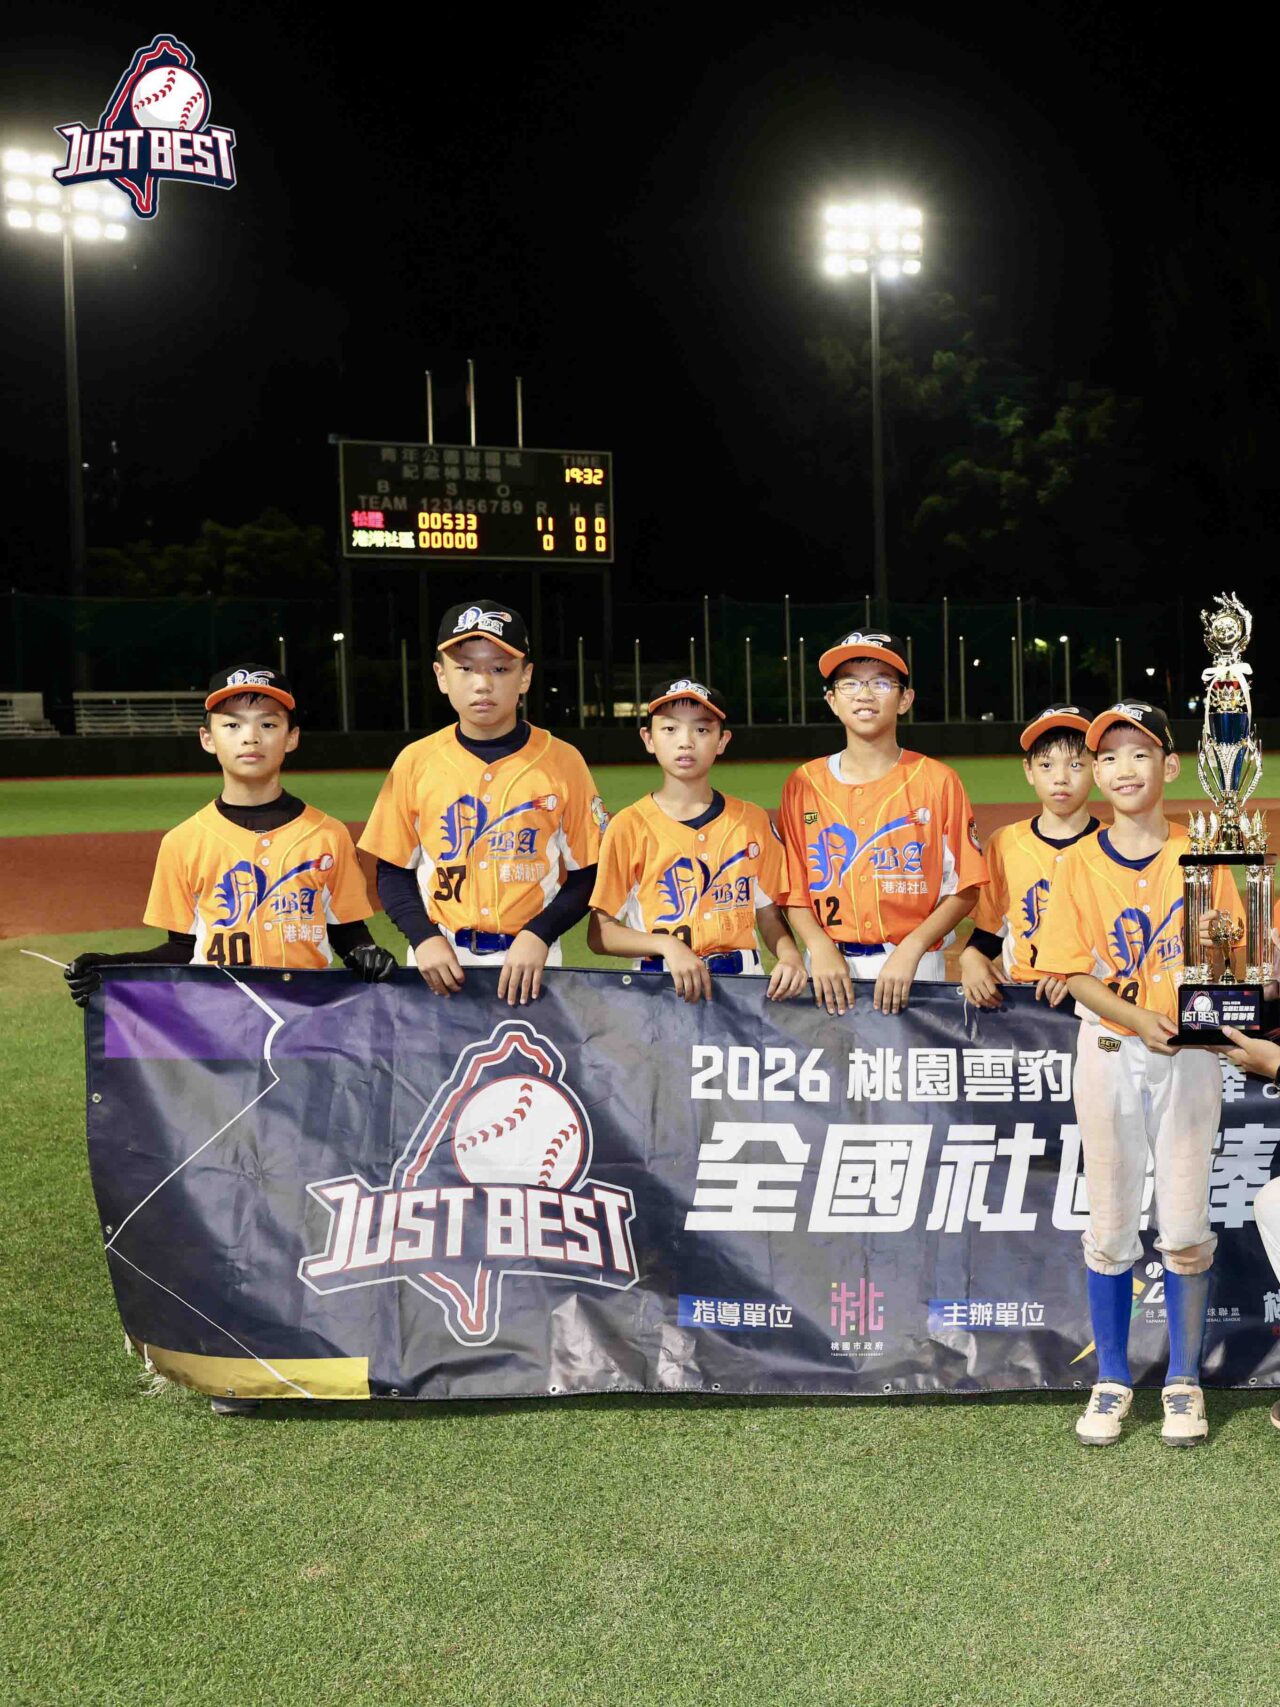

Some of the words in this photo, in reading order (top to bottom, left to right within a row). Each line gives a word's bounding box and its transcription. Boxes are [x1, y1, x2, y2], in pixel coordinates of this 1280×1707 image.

[561, 455, 600, 466] TIME
[377, 480, 390, 494] B
[446, 483, 458, 497] S
[358, 495, 408, 511] TEAM
[536, 502, 547, 514] R
[569, 503, 581, 516] H
[595, 503, 606, 516] E
[575, 516, 587, 533] 0
[594, 517, 606, 533] 0
[418, 531, 478, 550] 00000
[542, 534, 555, 551] 0
[575, 535, 587, 551] 0
[595, 535, 607, 552] 0
[433, 865, 467, 903] 97
[814, 896, 842, 928] 12
[206, 932, 252, 966] 40
[1181, 1011, 1197, 1022] UST
[1198, 1011, 1220, 1024] BEST
[690, 1045, 831, 1103] 2026
[847, 1047, 1072, 1103] 桃園雲豹
[306, 1182, 476, 1276] JUST
[484, 1186, 633, 1275] BEST
[692, 1299, 794, 1329] 指導單位
[942, 1301, 1045, 1328] 主辦單位
[830, 1341, 884, 1351] 桃園市政府
